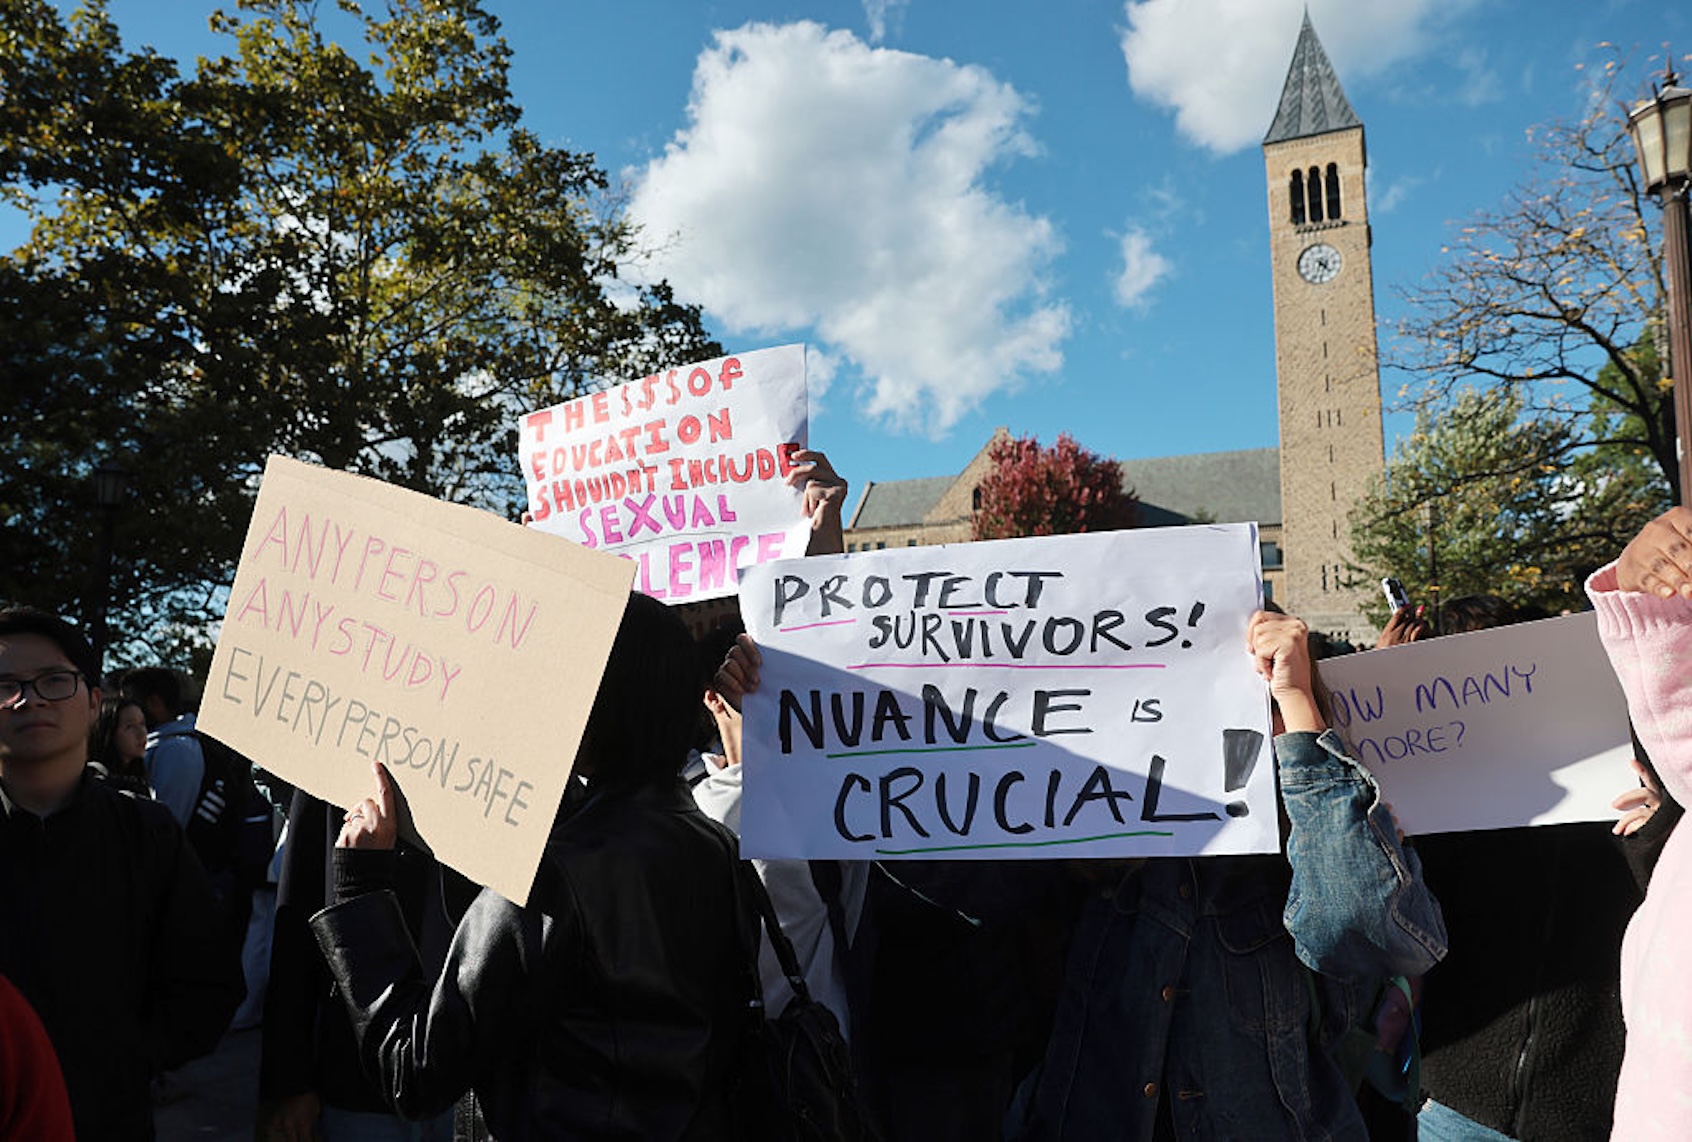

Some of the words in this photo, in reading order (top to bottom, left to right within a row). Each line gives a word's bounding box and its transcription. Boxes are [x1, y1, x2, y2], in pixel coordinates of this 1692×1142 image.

[527, 391, 609, 443] THE
[531, 407, 733, 482] EDUCATION
[667, 442, 800, 491] INCLUDE
[579, 493, 737, 549] SEXUAL
[252, 505, 354, 584] ANY
[354, 535, 540, 650] PERSON
[772, 571, 1064, 628] PROTECT
[237, 577, 335, 650] ANY
[330, 616, 462, 702] STUDY
[868, 601, 1205, 663] SURVIVORS!
[777, 683, 1095, 754] NUANCE
[1131, 698, 1164, 724] IS
[1329, 684, 1384, 729] OW
[1415, 662, 1537, 714] MANY
[222, 646, 342, 747] EVERY
[336, 699, 460, 790] PERSON
[454, 757, 535, 828] SAFE
[833, 728, 1265, 842] CRUCIAL!
